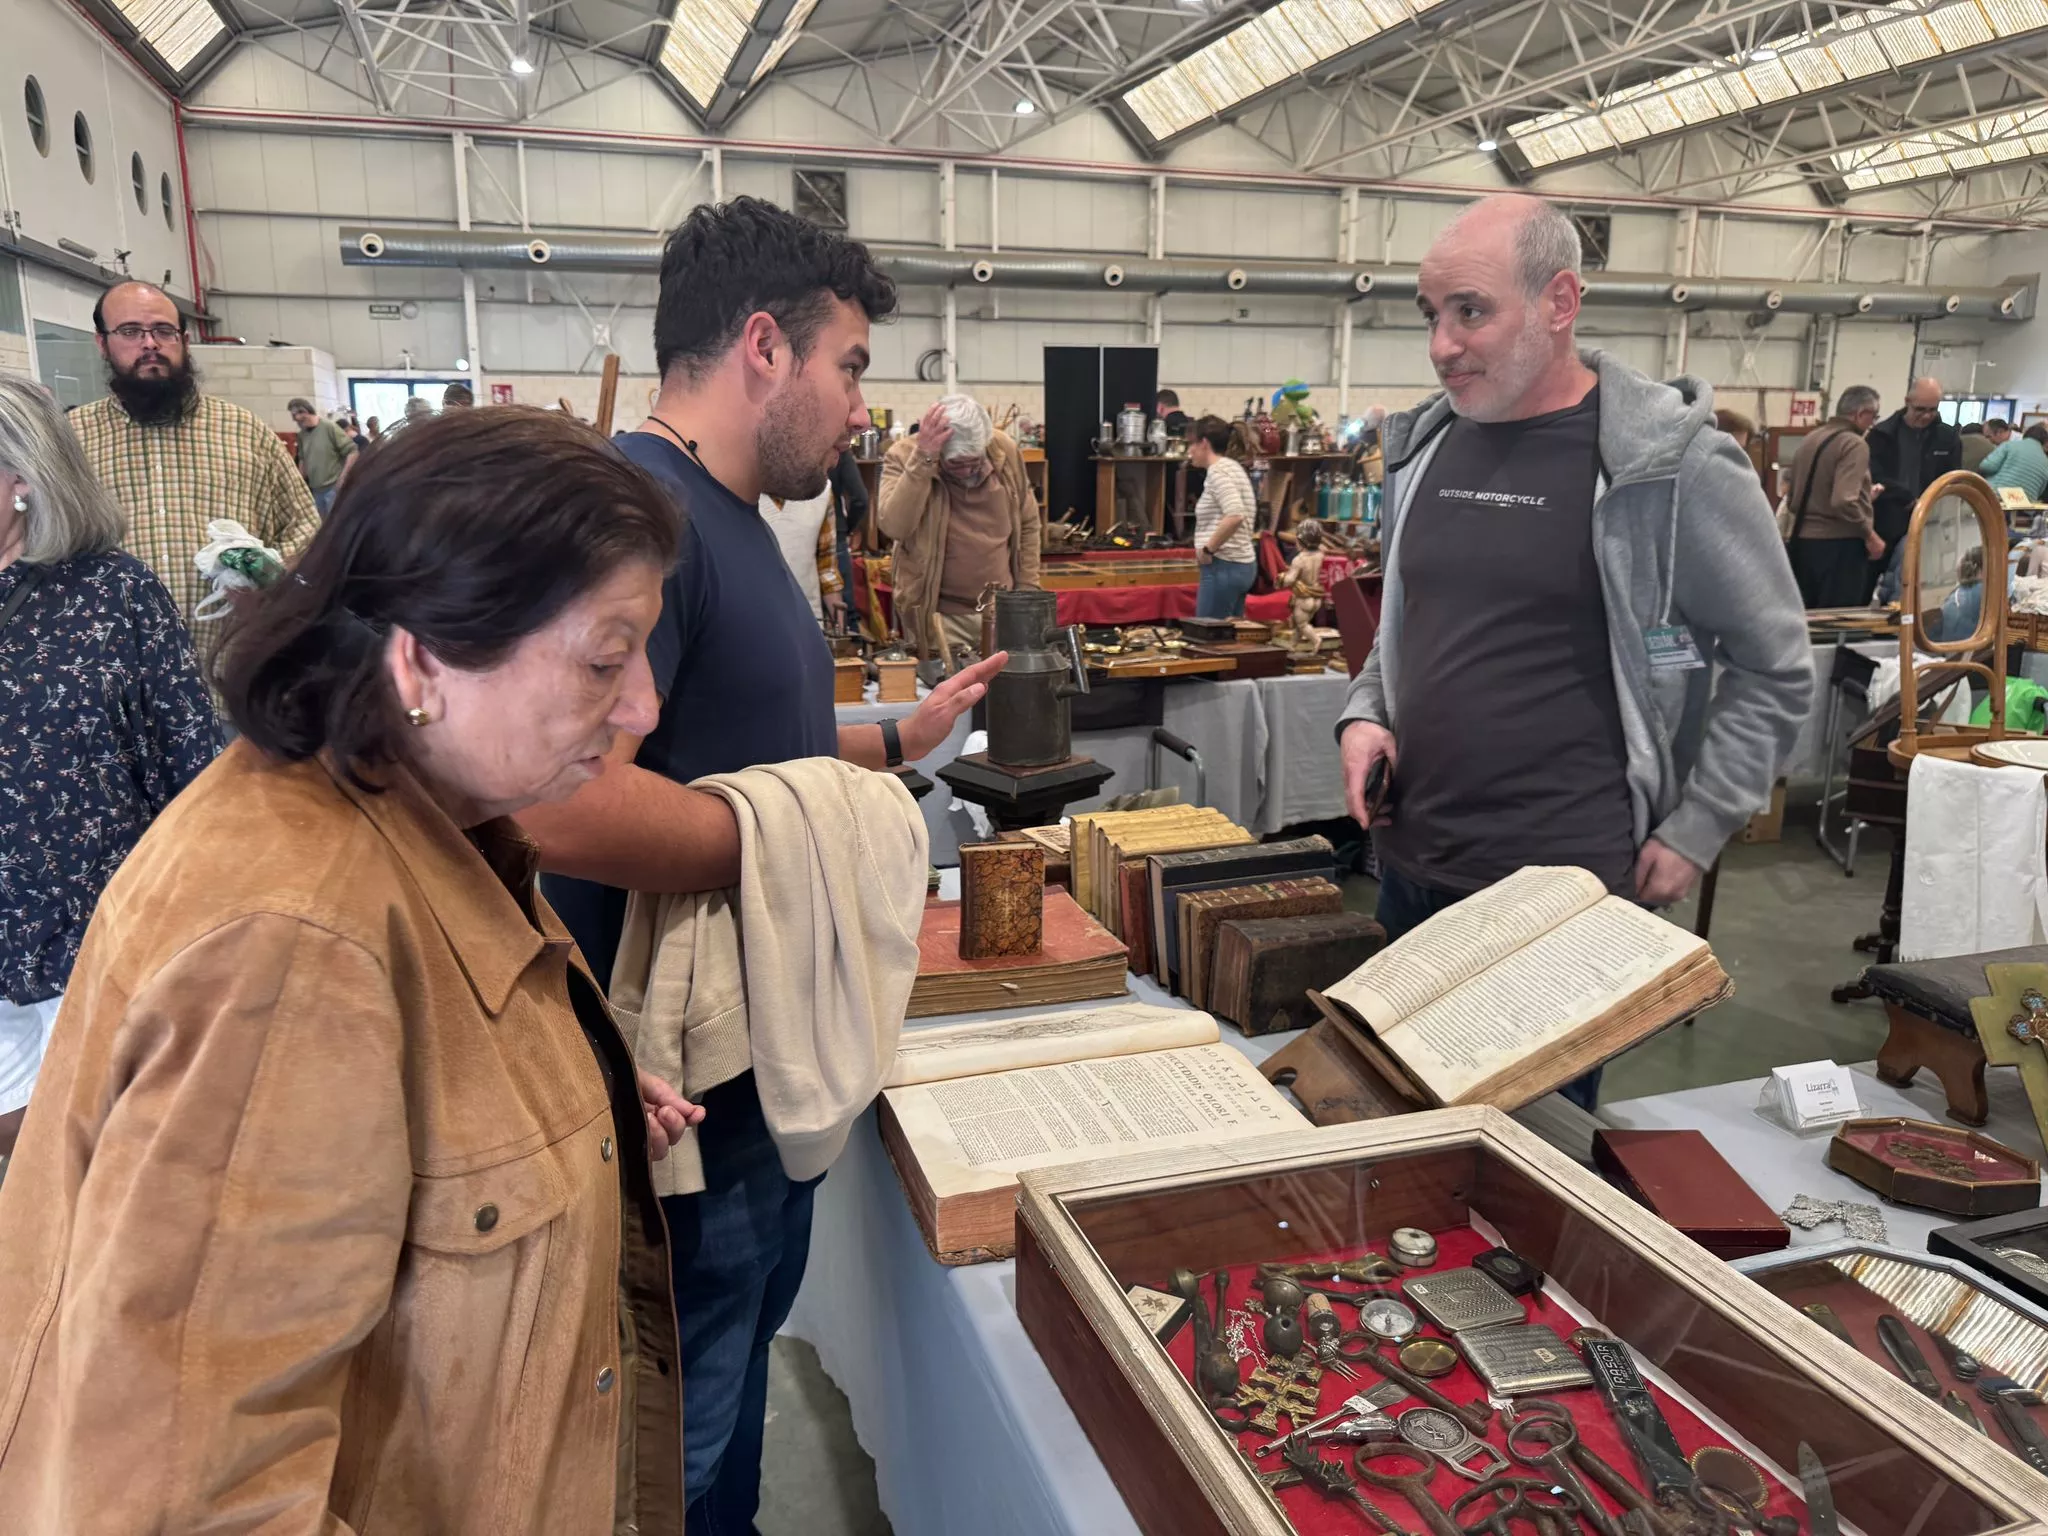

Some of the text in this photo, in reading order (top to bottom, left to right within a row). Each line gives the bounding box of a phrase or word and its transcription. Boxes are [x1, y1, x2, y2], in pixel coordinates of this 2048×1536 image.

[1438, 488, 1545, 506] OUTSIDE MOTORCYCLE
[1806, 1082, 1831, 1093] Lizarra
[1596, 1344, 1626, 1385] RASOIR
